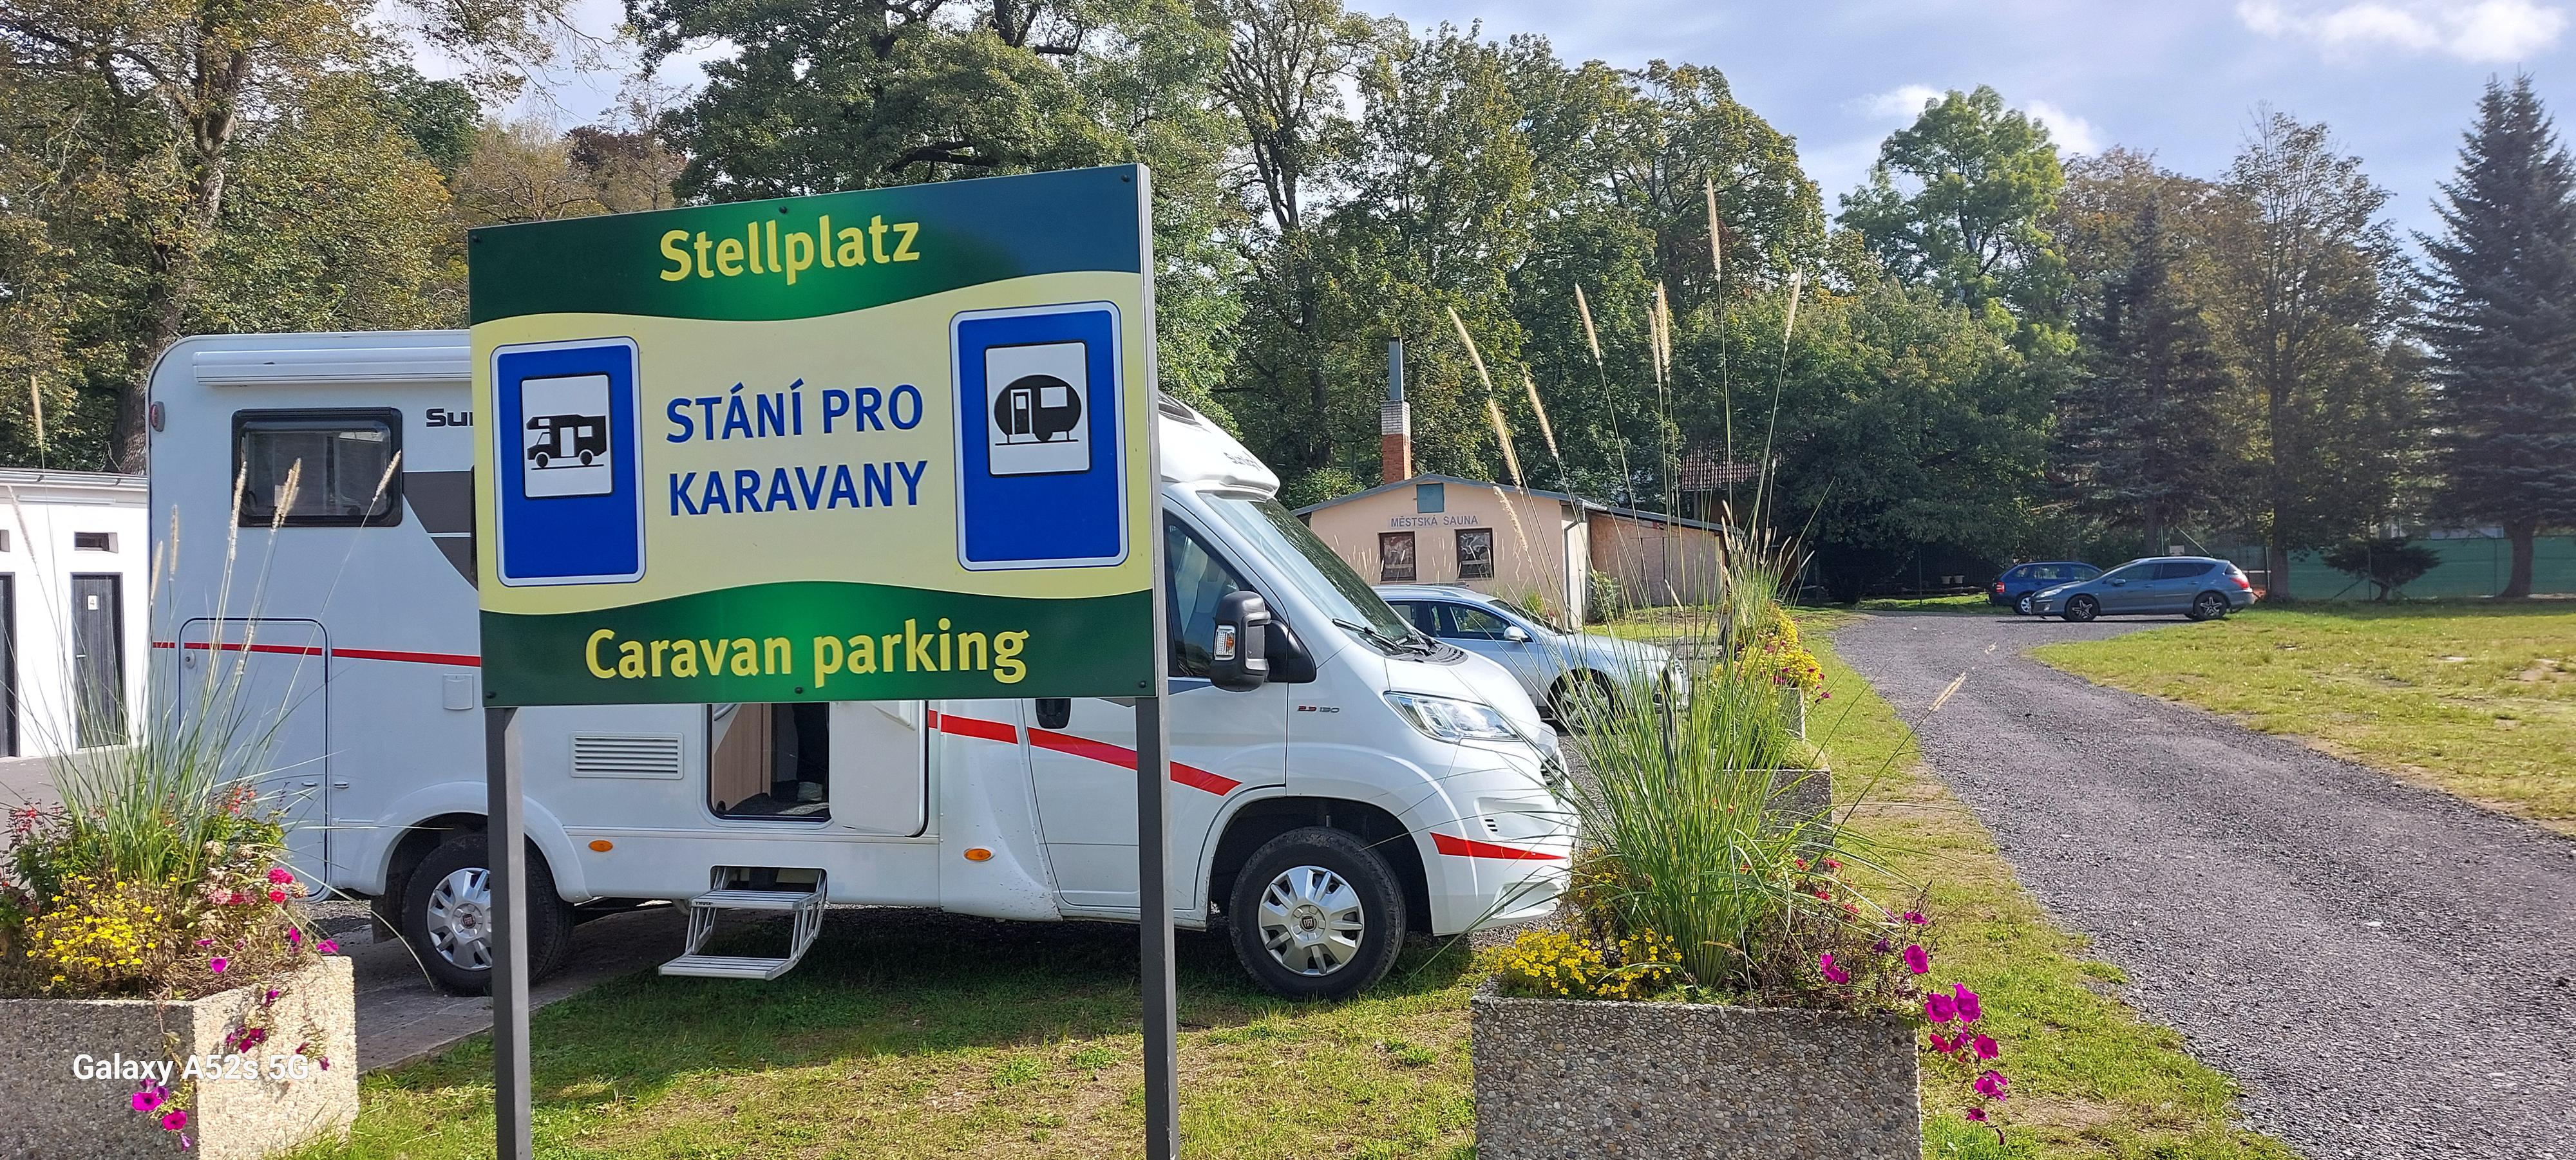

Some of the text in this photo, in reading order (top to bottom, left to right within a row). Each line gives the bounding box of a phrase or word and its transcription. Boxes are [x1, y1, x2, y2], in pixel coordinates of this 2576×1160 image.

[659, 214, 920, 286] Stellplatz
[426, 408, 473, 427] Su
[666, 378, 923, 443] STÁNÍ PRO
[669, 460, 927, 516] KARAVANY
[1391, 515, 1479, 527] MĚSTSKÁ SAUNA
[585, 618, 1030, 688] Caravan parking
[1303, 918, 1313, 927] FIAT
